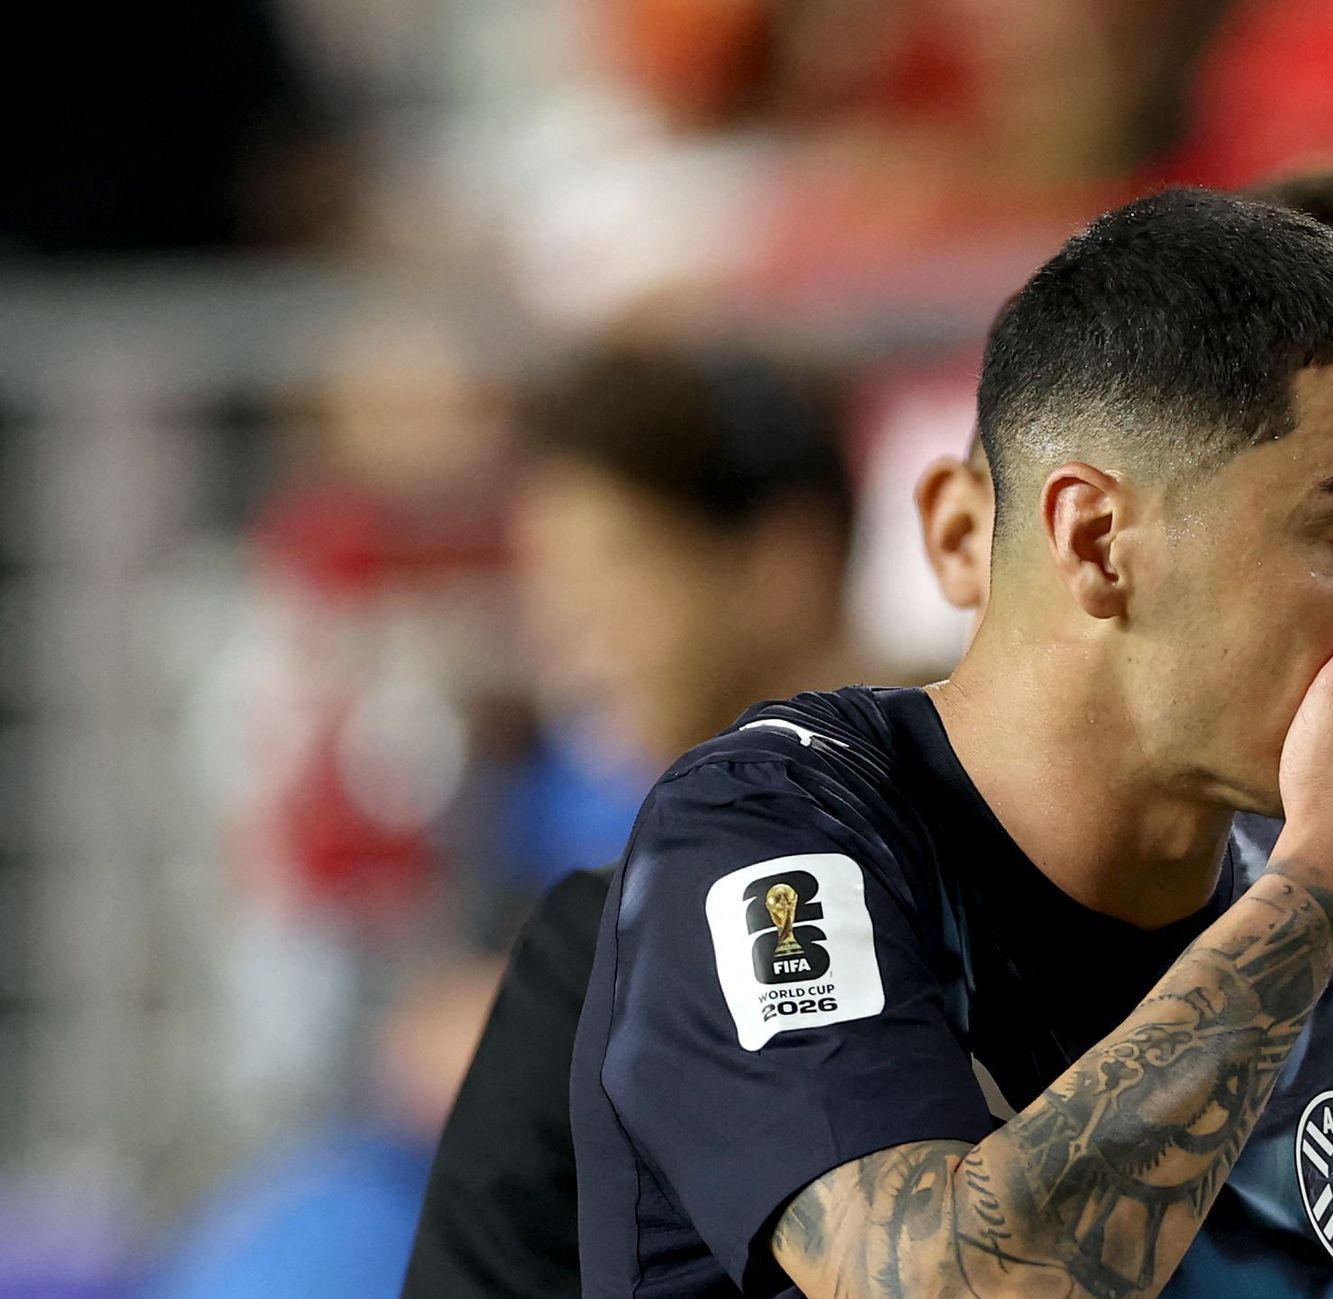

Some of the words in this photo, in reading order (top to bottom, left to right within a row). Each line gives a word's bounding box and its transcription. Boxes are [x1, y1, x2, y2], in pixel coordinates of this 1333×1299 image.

[773, 958, 812, 975] FIFA
[758, 988, 805, 1004] WORLD
[808, 984, 836, 996] CUP
[761, 997, 839, 1023] 2026
